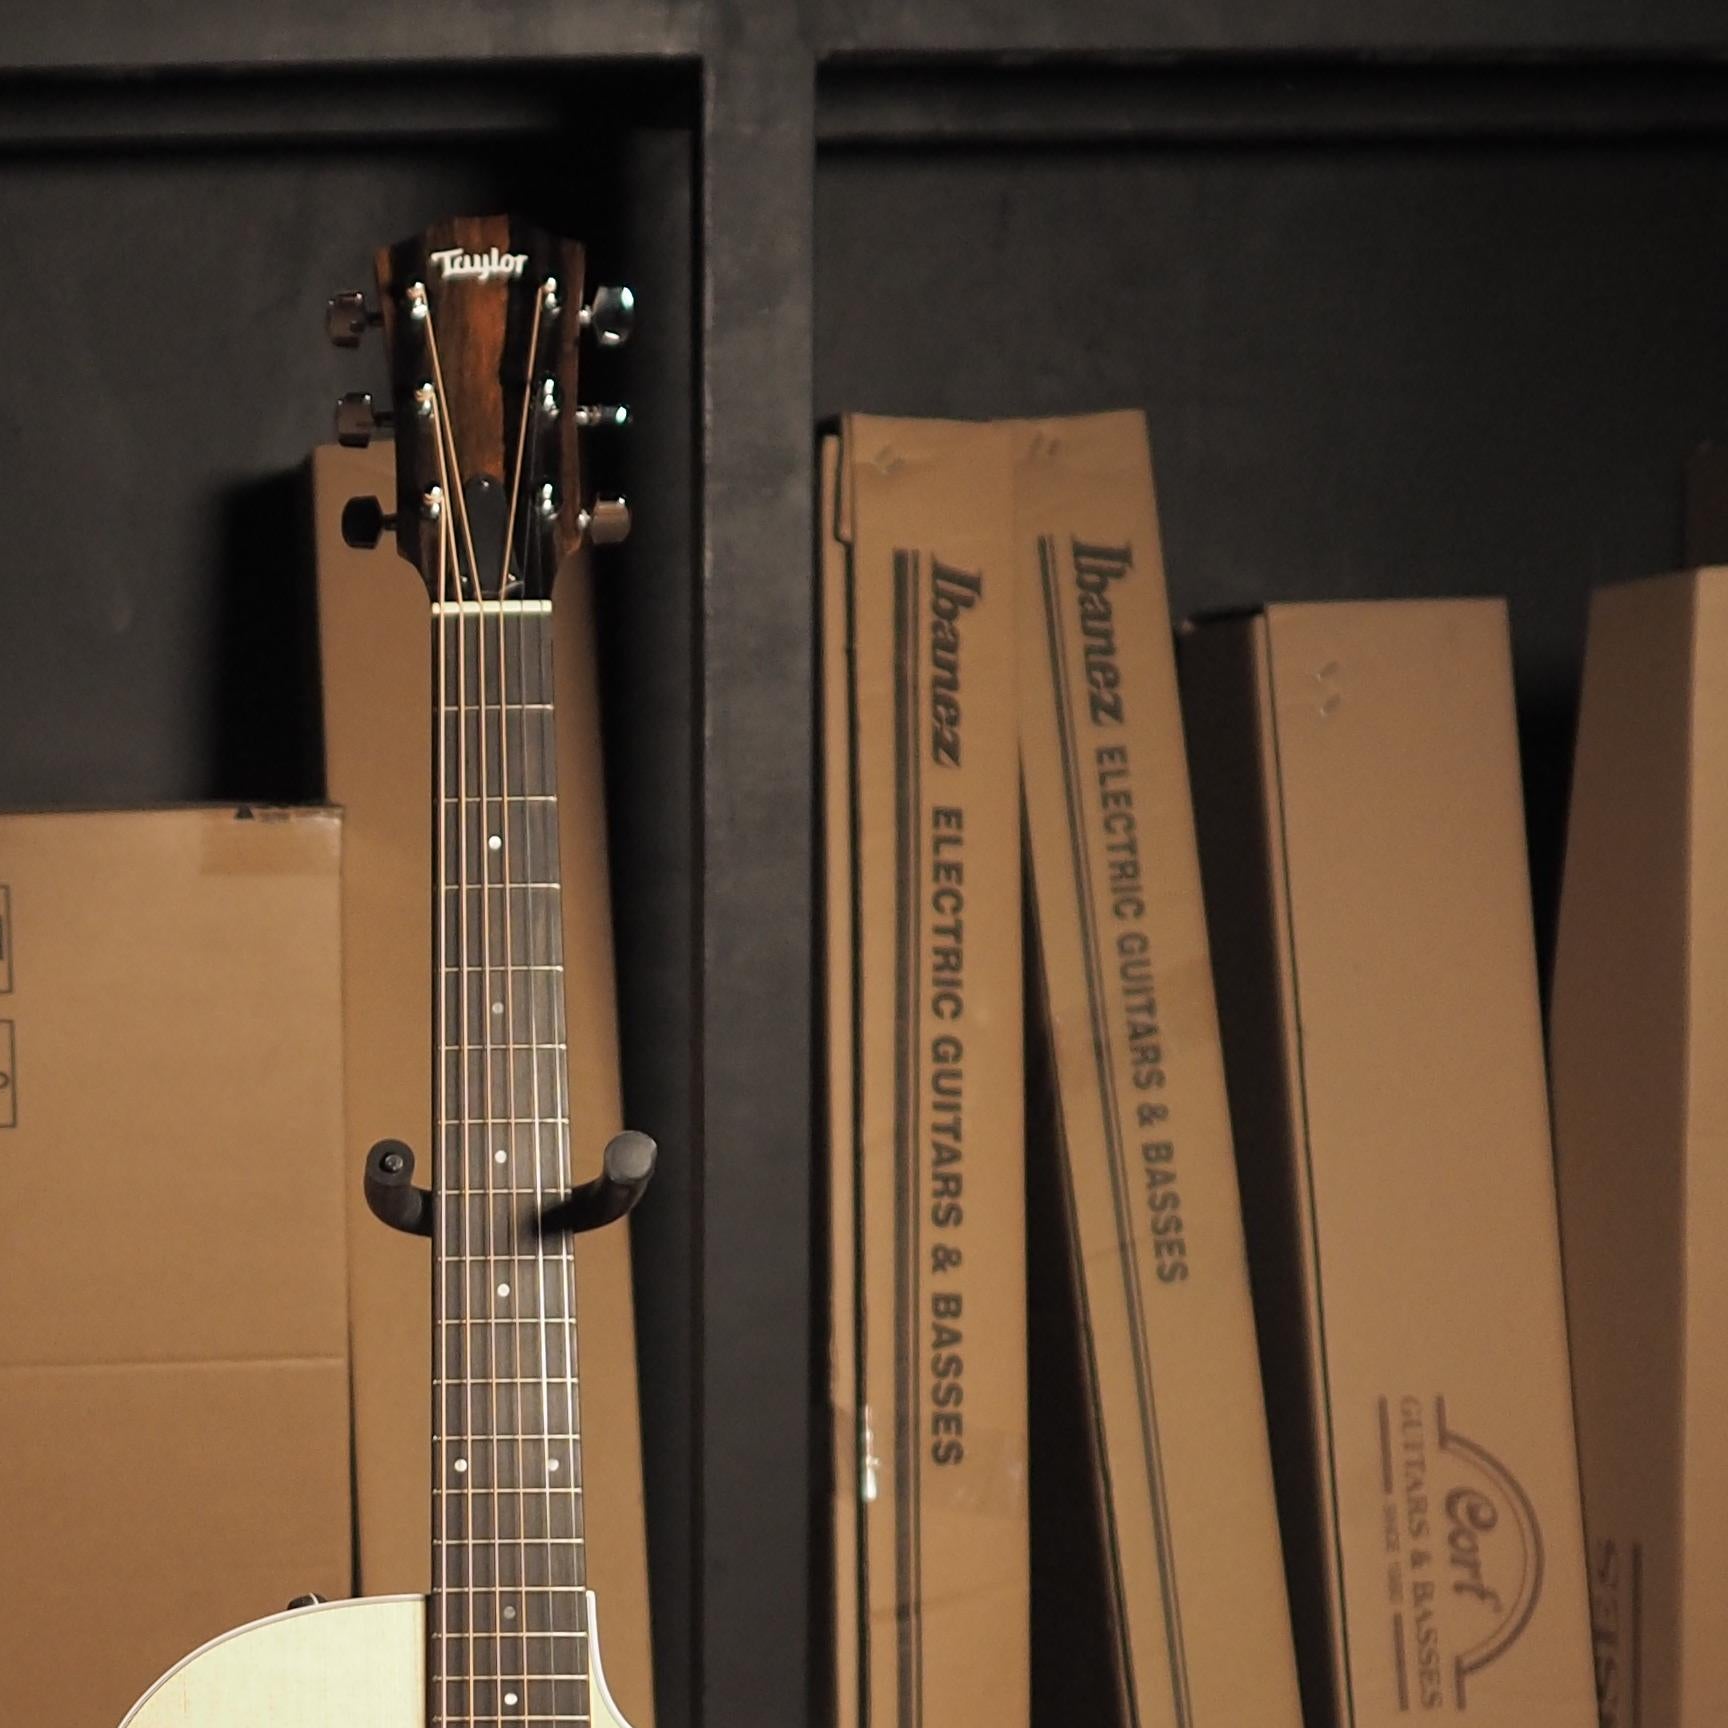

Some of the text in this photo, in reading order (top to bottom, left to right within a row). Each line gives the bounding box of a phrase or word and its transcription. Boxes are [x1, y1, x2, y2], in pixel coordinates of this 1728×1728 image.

[431, 247, 528, 279] Taylor
[931, 550, 982, 1467] Ibanez ELECTRIC GUITARS & BASSES
[1072, 540, 1189, 1285] Ibanez ELECTRIC GUITARS & BASSES
[1399, 1394, 1443, 1711] GUITARS & BASSES
[1445, 1486, 1503, 1614] Cort
